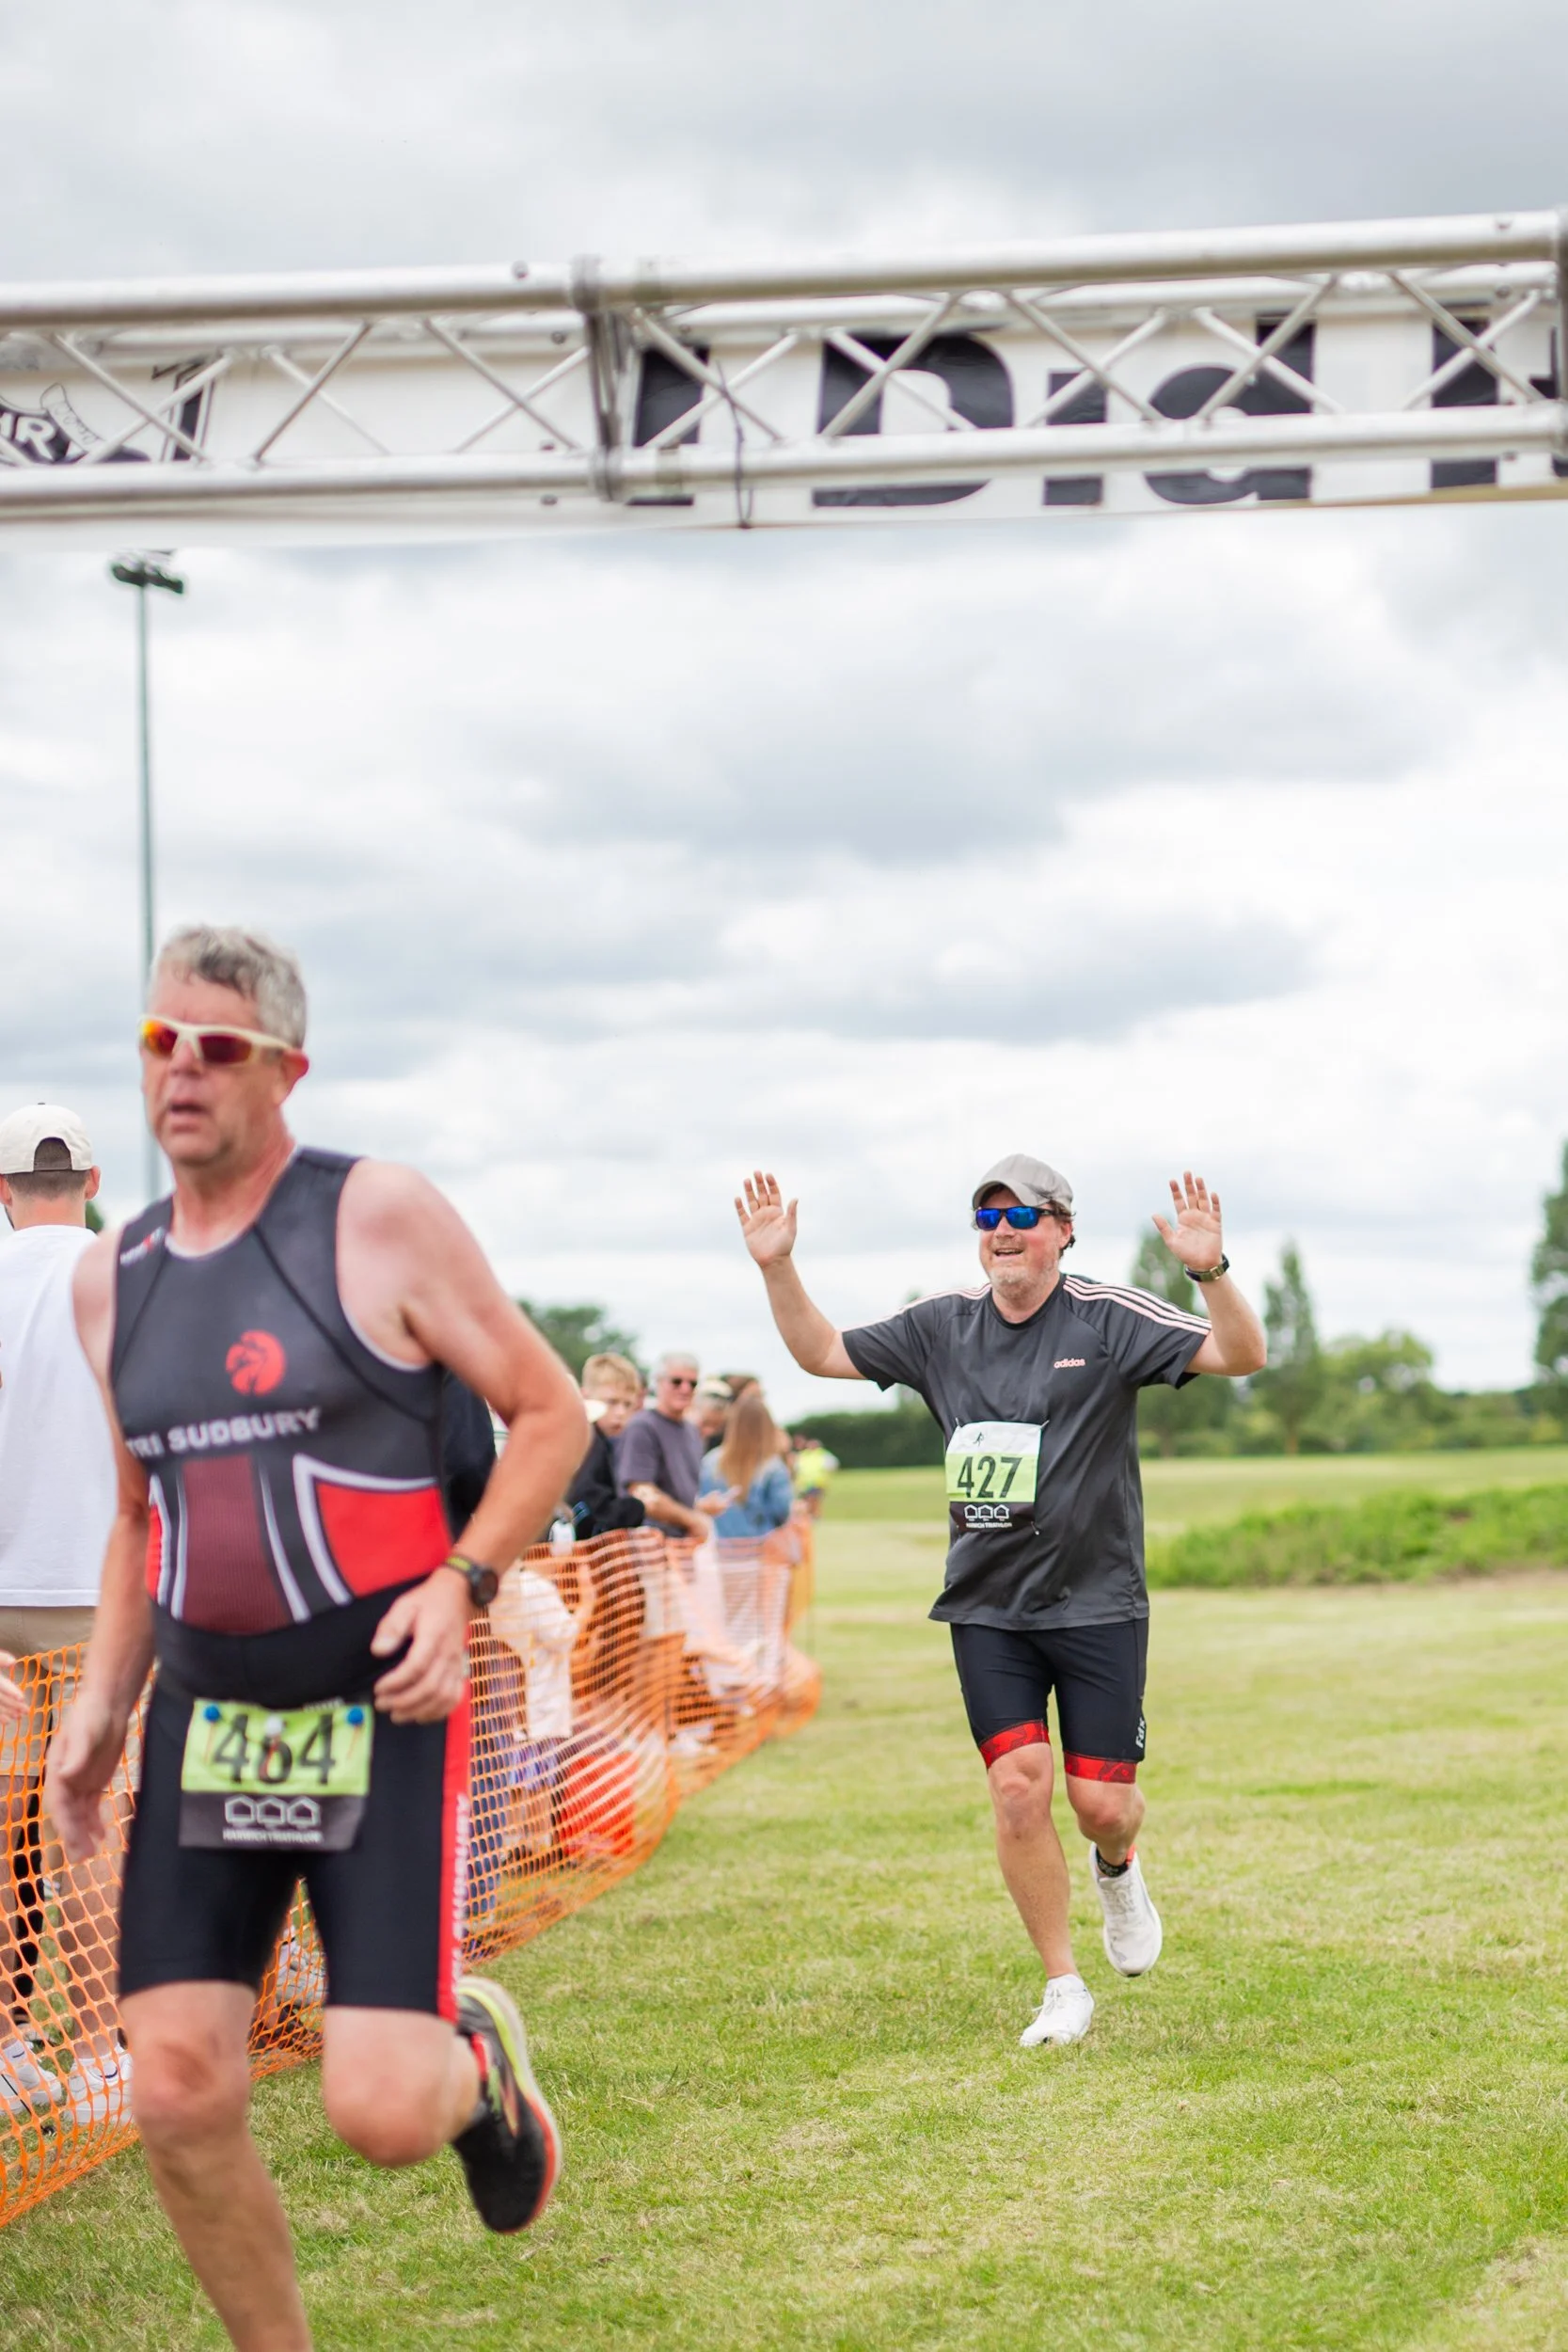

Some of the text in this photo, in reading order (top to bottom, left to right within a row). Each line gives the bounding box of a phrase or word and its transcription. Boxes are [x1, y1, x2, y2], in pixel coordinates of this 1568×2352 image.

[1053, 1358, 1085, 1369] adidas
[166, 1406, 321, 1454] SUDBURY
[957, 1455, 1022, 1499] 427
[213, 1713, 336, 1786] 464
